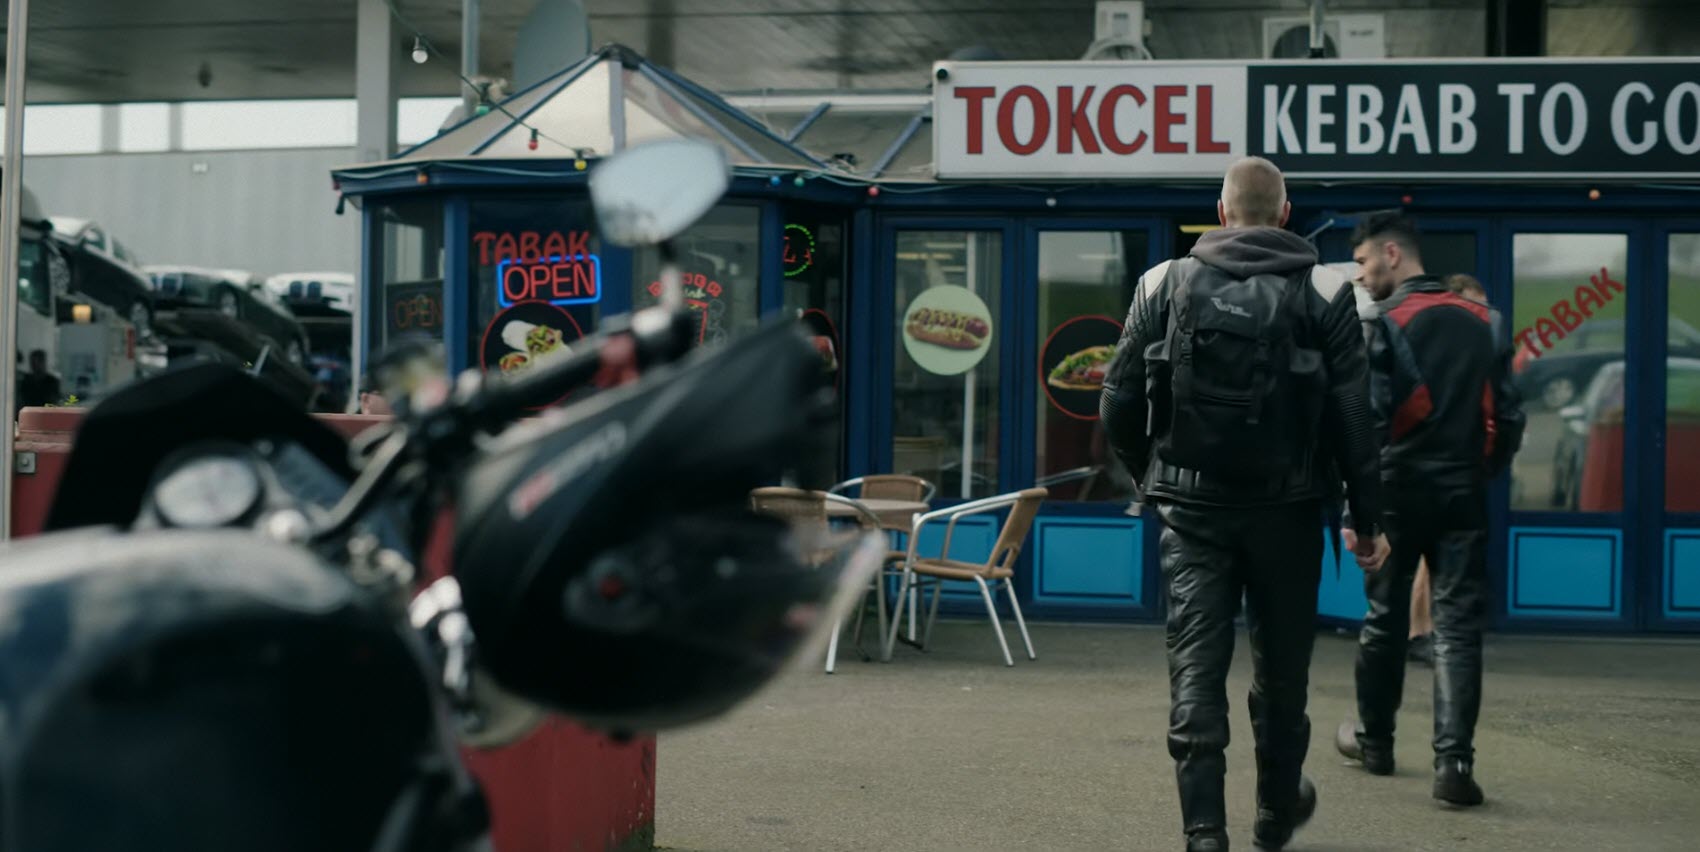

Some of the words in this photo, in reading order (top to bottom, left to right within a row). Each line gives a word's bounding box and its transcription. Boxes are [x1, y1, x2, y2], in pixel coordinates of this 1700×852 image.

[954, 84, 1231, 155] TOKCEL
[1263, 84, 1477, 154] KEBAB
[1498, 82, 1588, 155] TO
[1610, 81, 1700, 155] GO
[473, 231, 590, 265] TABAK
[504, 262, 596, 300] OPEN
[1514, 266, 1625, 358] TABAK
